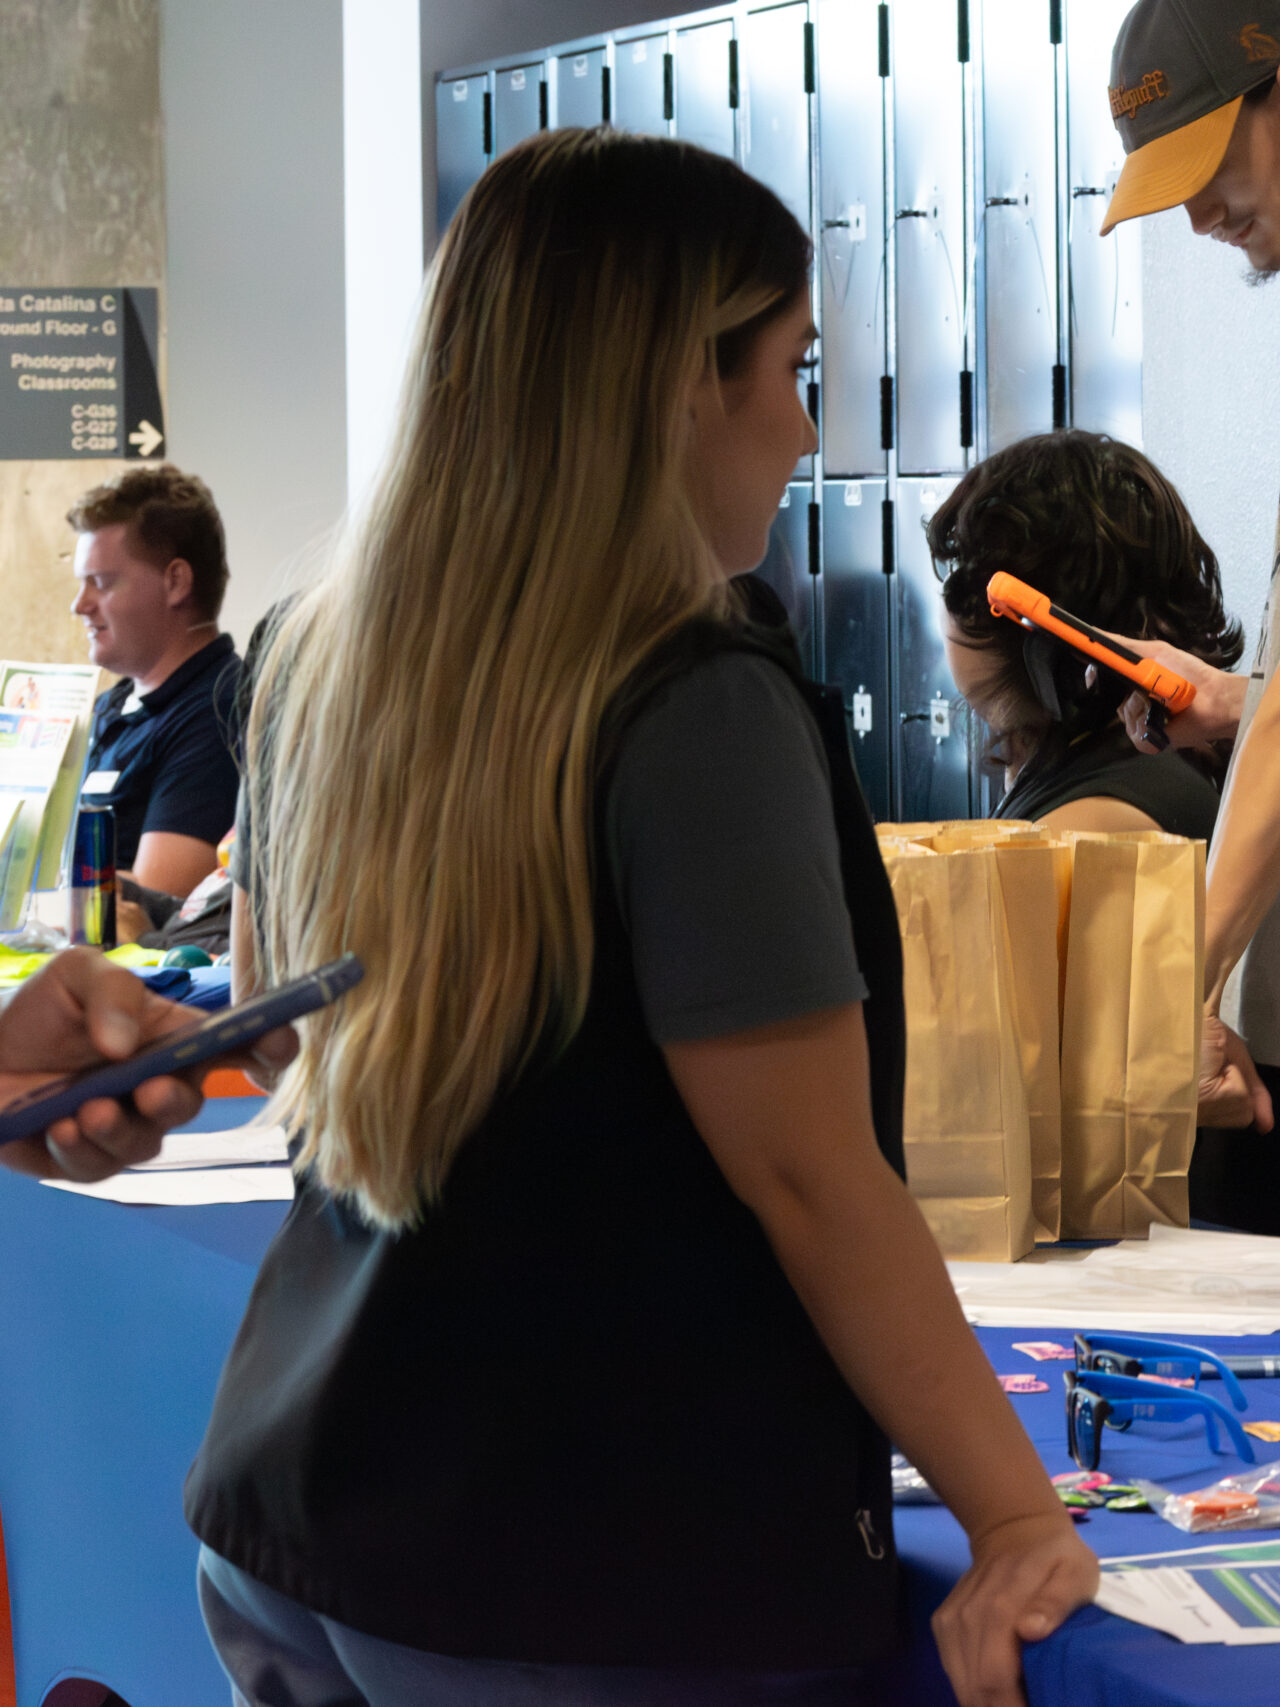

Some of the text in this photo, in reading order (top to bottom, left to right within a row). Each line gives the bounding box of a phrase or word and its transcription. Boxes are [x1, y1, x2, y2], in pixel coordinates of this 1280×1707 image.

[19, 294, 96, 313] Catalina
[100, 294, 117, 313] C
[45, 319, 89, 336] Floor
[102, 319, 117, 336] G
[10, 352, 117, 373] Photography
[18, 374, 117, 391] Classrooms
